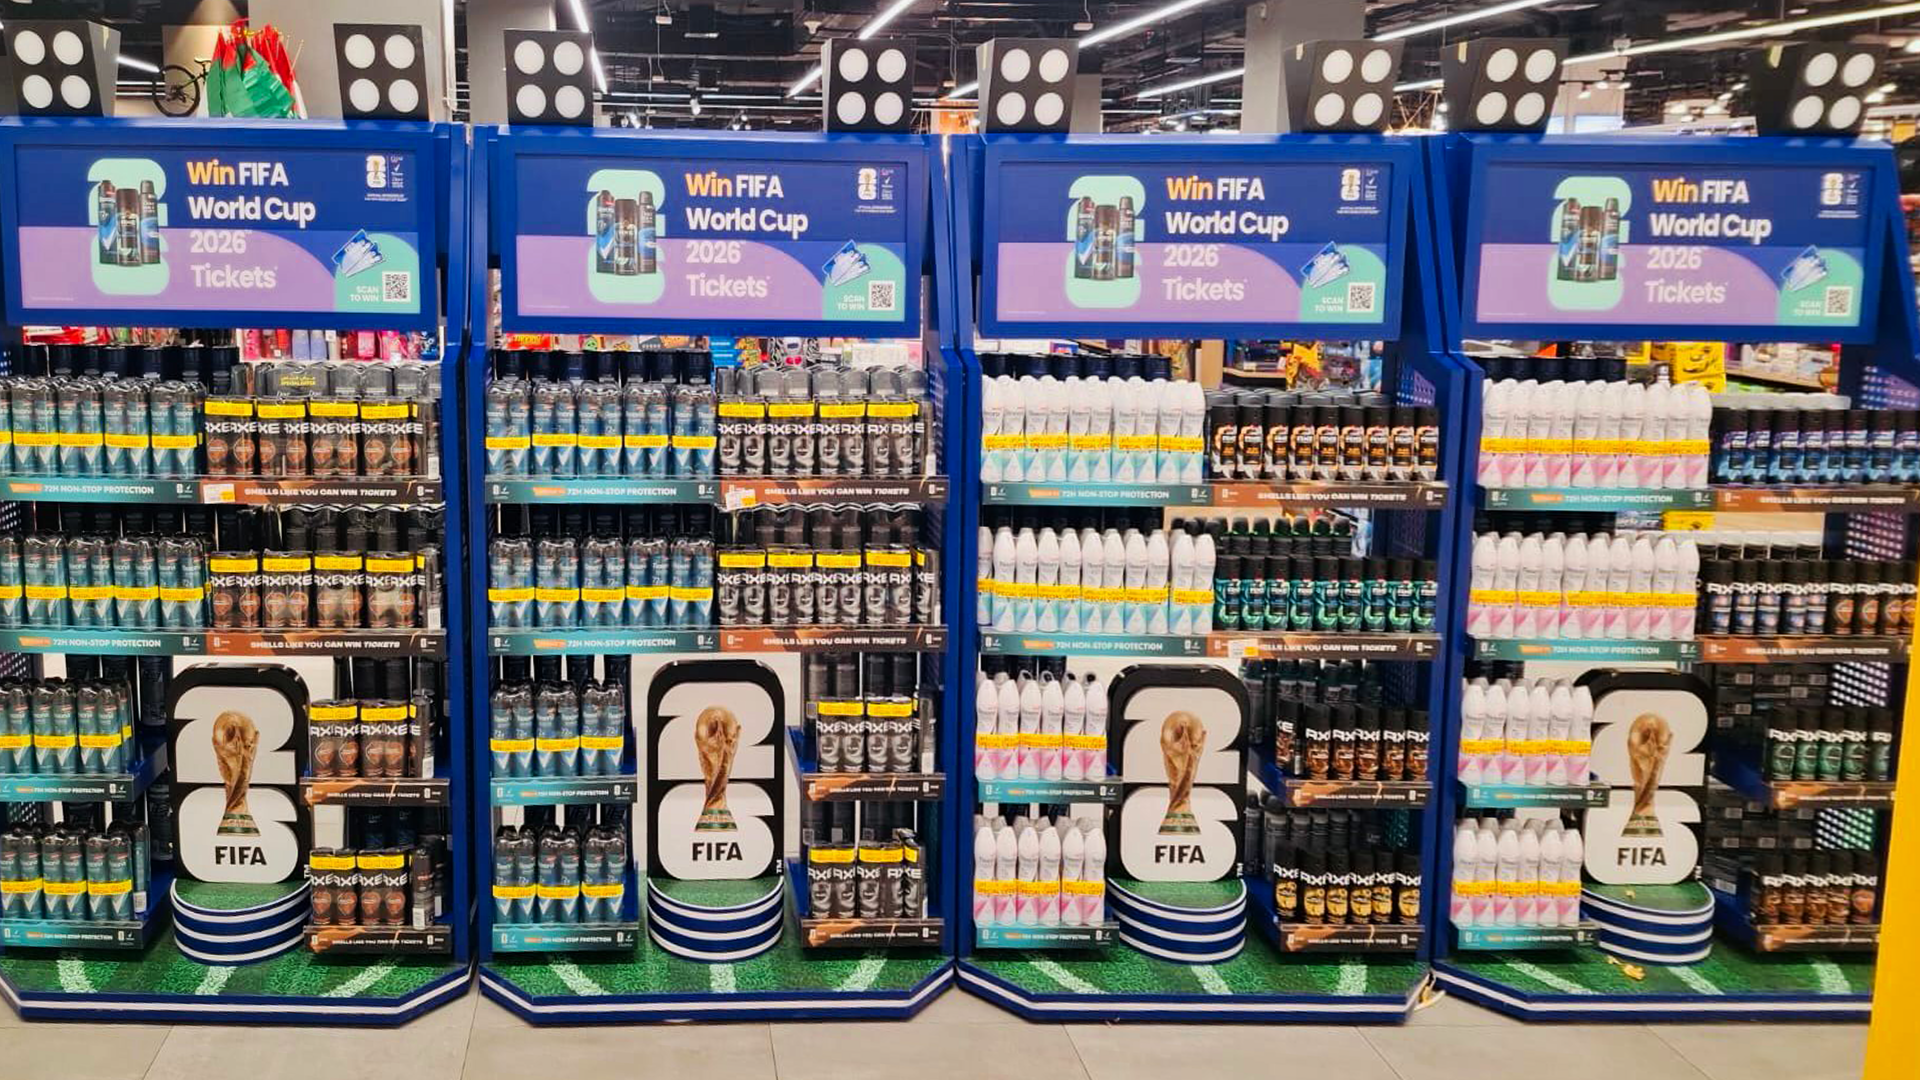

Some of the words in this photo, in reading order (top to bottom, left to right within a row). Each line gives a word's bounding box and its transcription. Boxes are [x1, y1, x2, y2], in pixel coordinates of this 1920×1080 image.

[187, 159, 235, 186] Win
[238, 162, 289, 187] FIFA
[685, 171, 732, 198] Win
[736, 175, 784, 198] FIFA
[1166, 175, 1213, 200] Win
[1217, 178, 1265, 200] FIFA
[1653, 178, 1699, 203] Win
[1702, 180, 1749, 203] FIFA
[188, 196, 261, 220] World
[264, 198, 316, 228] Cup
[685, 207, 756, 231] World
[759, 209, 809, 240] Cup
[1165, 211, 1236, 234] World
[1239, 212, 1289, 242] Cup
[1650, 213, 1721, 236] World
[1723, 215, 1772, 245] Cup
[350, 294, 363, 302] TO
[364, 294, 379, 302] WIN
[357, 286, 379, 294] SCAN
[61, 486, 102, 494] NON-STOP
[103, 486, 154, 494] PROTECTION
[583, 487, 625, 496] NON-STOP
[627, 487, 677, 496] PROTECTION
[1077, 490, 1119, 498] NON-STOP
[1120, 491, 1169, 499] PROTECTION
[584, 639, 625, 647] NON-STOP
[626, 639, 676, 647] PROTECTION
[1072, 642, 1113, 650] NON-STOP
[215, 846, 267, 866] FIFA
[692, 842, 743, 861] FIFA
[1154, 845, 1206, 863] FIFA
[1617, 847, 1667, 866] FIFA
